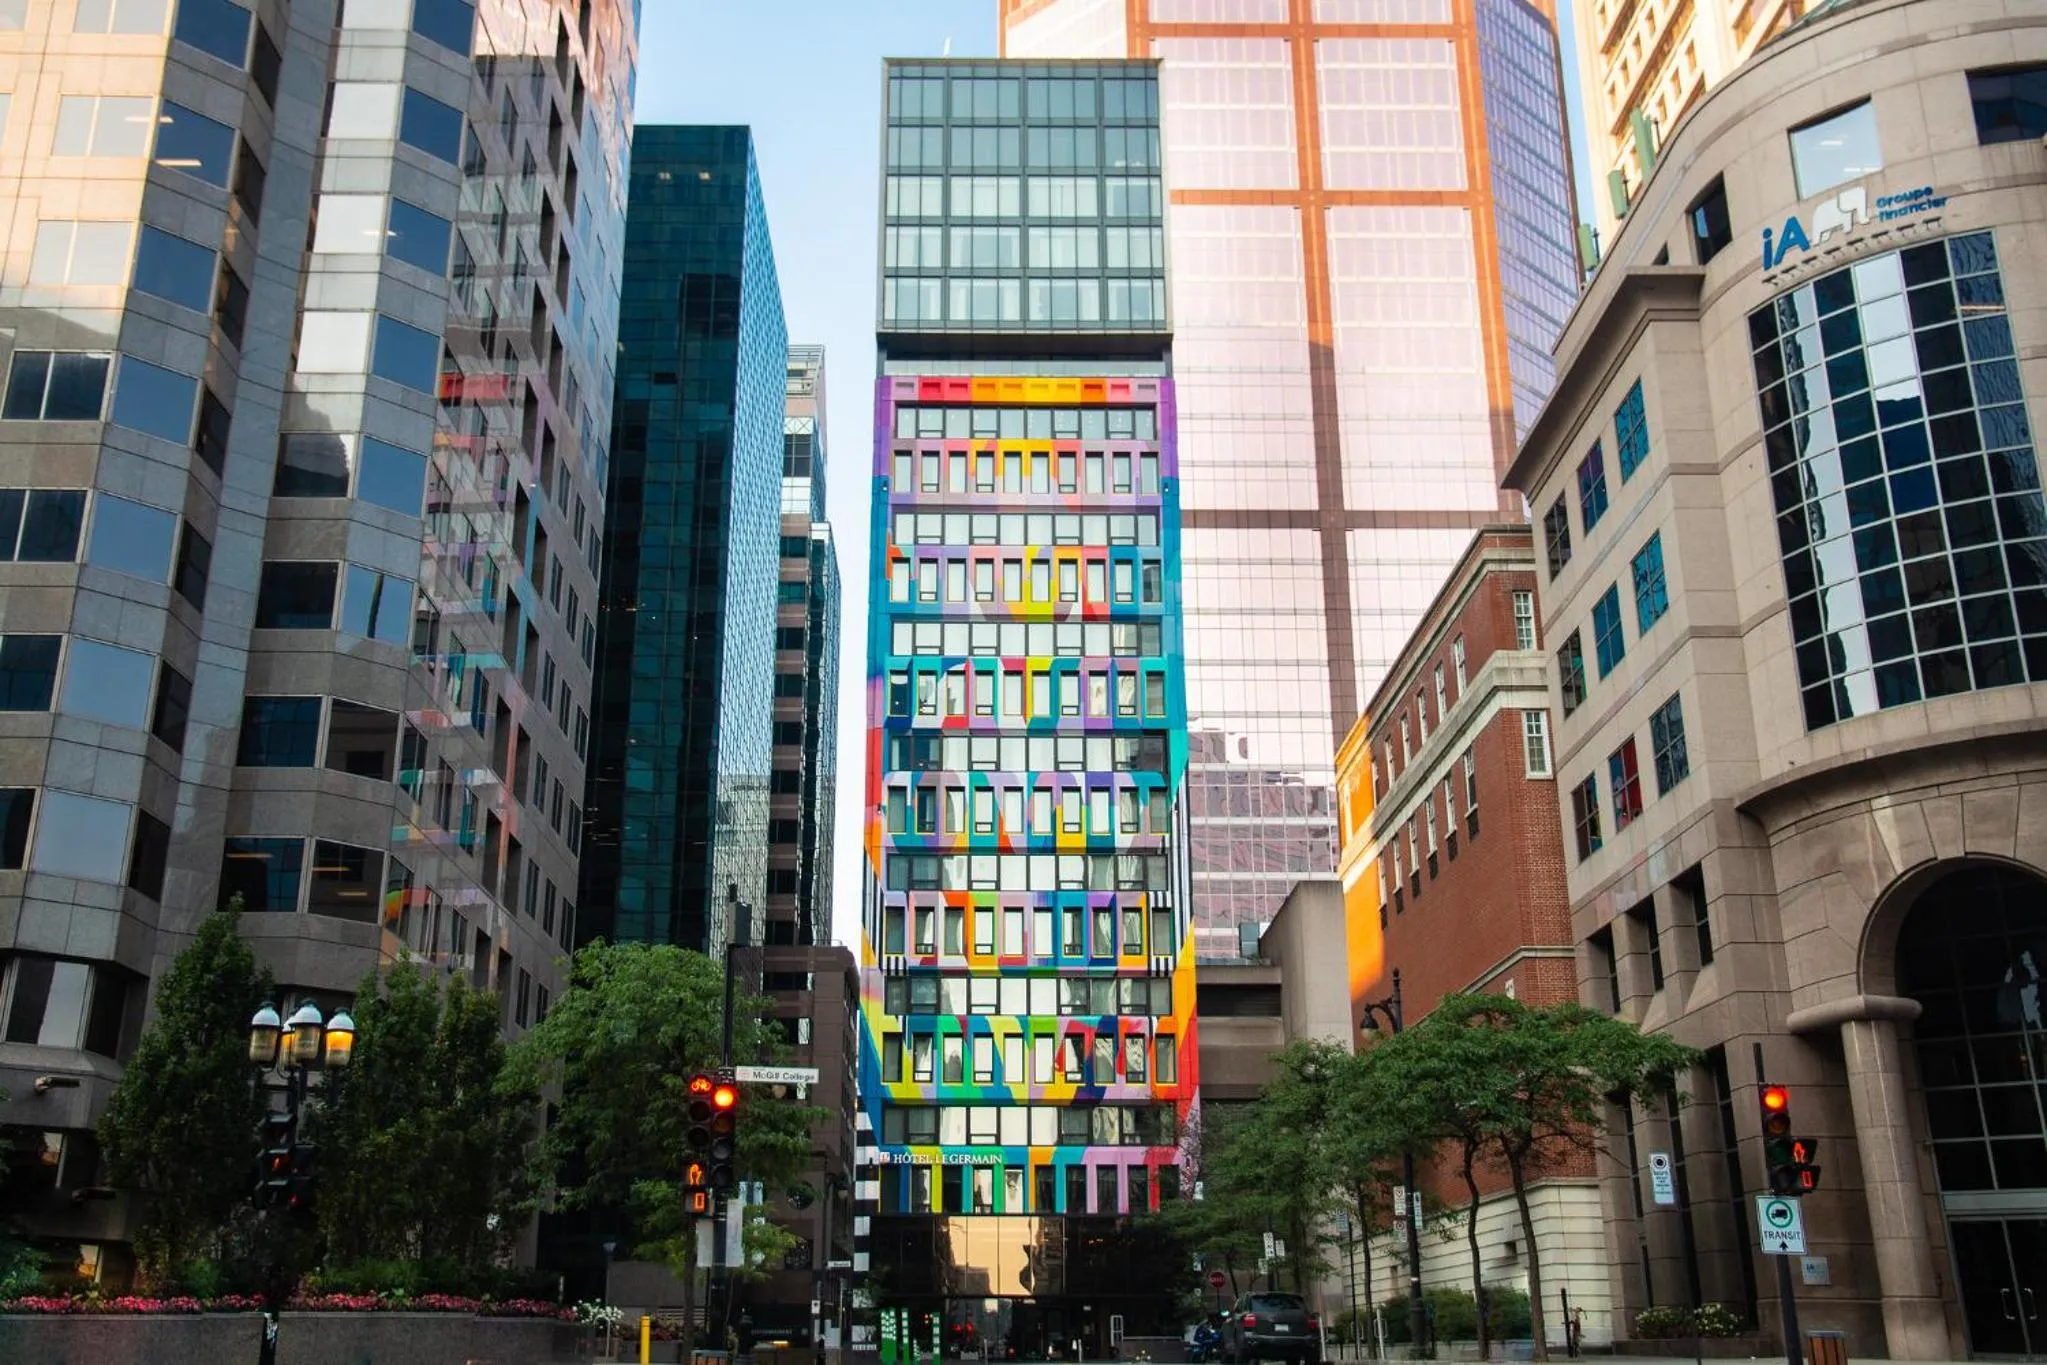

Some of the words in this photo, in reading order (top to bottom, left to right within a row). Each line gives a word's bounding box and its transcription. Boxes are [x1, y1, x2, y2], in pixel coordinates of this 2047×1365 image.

[1875, 185, 1934, 210] Groupe
[1878, 196, 1948, 222] financier
[1762, 216, 1810, 271] iA
[753, 1071, 780, 1080] McGill
[783, 1072, 815, 1082] College
[893, 1152, 933, 1164] HÔTEL
[949, 1154, 1002, 1164] GERMAIN
[1763, 1230, 1801, 1240] TRANSIT
